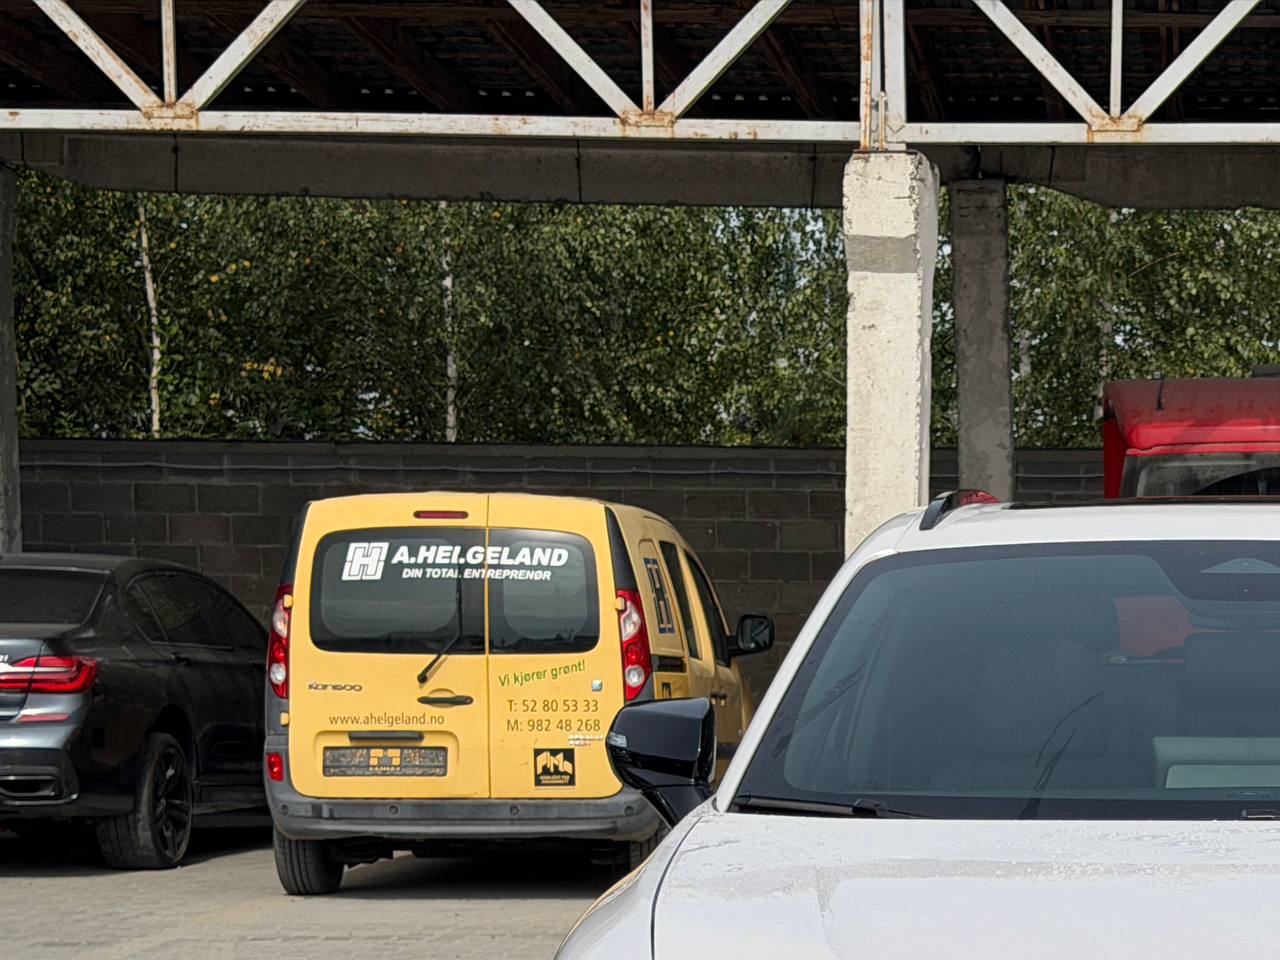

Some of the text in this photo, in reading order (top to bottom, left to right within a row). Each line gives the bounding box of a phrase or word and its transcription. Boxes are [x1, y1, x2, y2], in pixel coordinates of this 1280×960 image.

[402, 568, 422, 579] DIN
[463, 568, 552, 581] ENTREPRENØR
[498, 659, 586, 687] Vi kjører grønt!
[507, 699, 599, 712] T: 52 80 53 33
[328, 712, 445, 727] www.ahelgeland.no
[506, 719, 601, 732] M: 982 48 268
